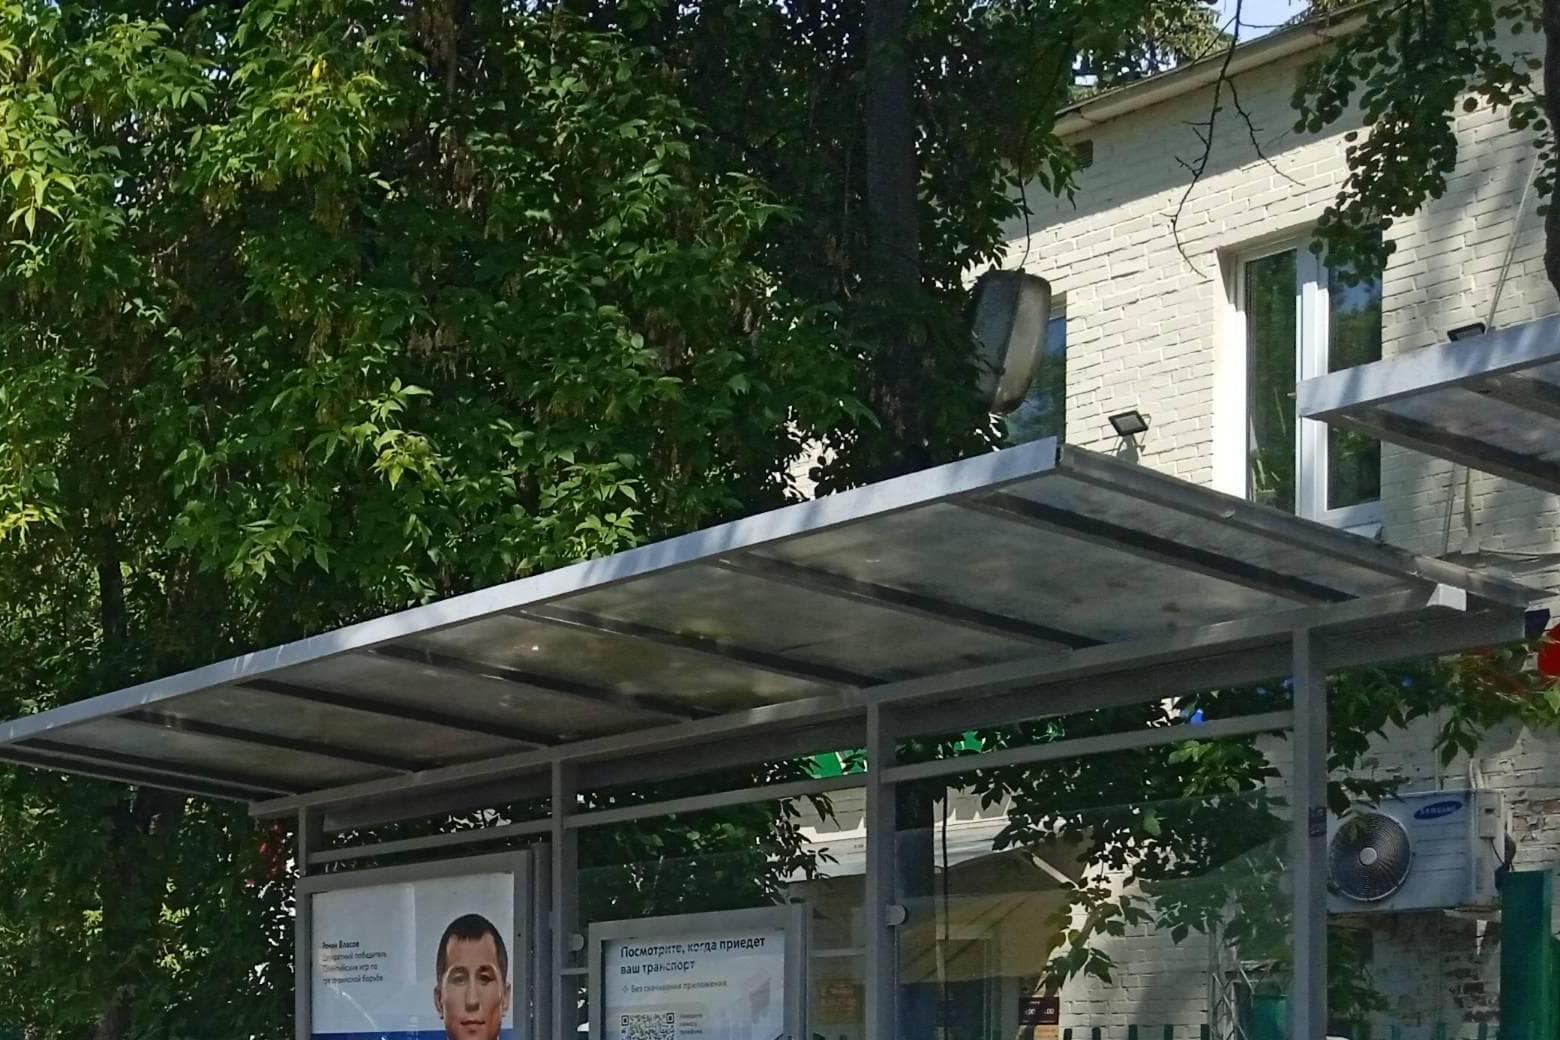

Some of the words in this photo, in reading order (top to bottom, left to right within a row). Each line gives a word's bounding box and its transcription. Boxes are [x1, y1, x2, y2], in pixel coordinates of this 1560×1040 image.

[620, 944, 686, 958] Посмотрите,
[687, 942, 717, 953] когда
[719, 936, 766, 951] приедет
[620, 965, 640, 975] ваш
[642, 959, 696, 975] транспорт
